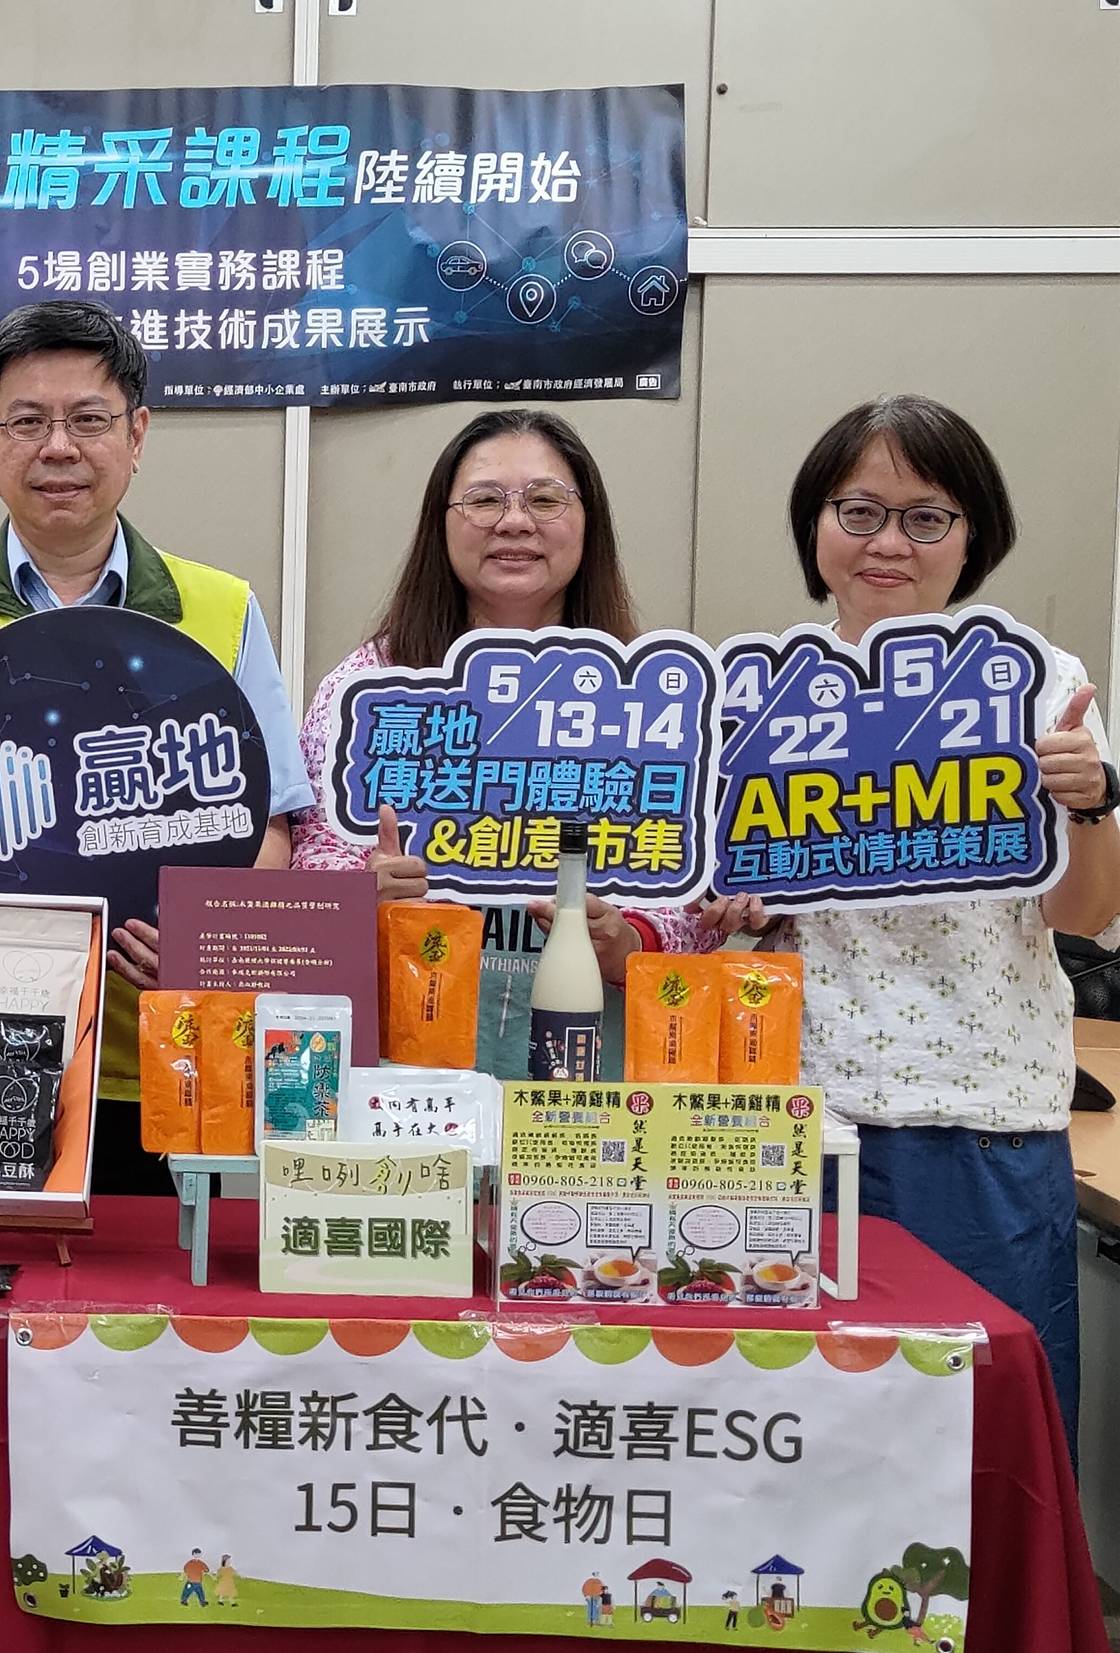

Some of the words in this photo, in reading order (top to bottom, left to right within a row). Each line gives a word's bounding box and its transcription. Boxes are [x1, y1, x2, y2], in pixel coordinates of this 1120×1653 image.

[354, 148, 582, 206] 陸續開始
[17, 247, 346, 292] 5場創業實務課程
[115, 306, 431, 350] 進技術成果展示
[639, 377, 658, 388] 廣告
[367, 703, 479, 758] 贏地
[74, 712, 246, 816] 贏地
[363, 758, 688, 815] 傳送門體驗日
[729, 755, 1026, 843] AR+MR
[79, 807, 250, 853] 創新育成基地
[425, 814, 685, 873] &創意市集
[727, 821, 1029, 884] 互動式情境策展
[522, 1175, 614, 1188] 0960-805-218
[681, 1179, 773, 1192] 0960-805-218
[281, 1216, 453, 1259] 適喜國際
